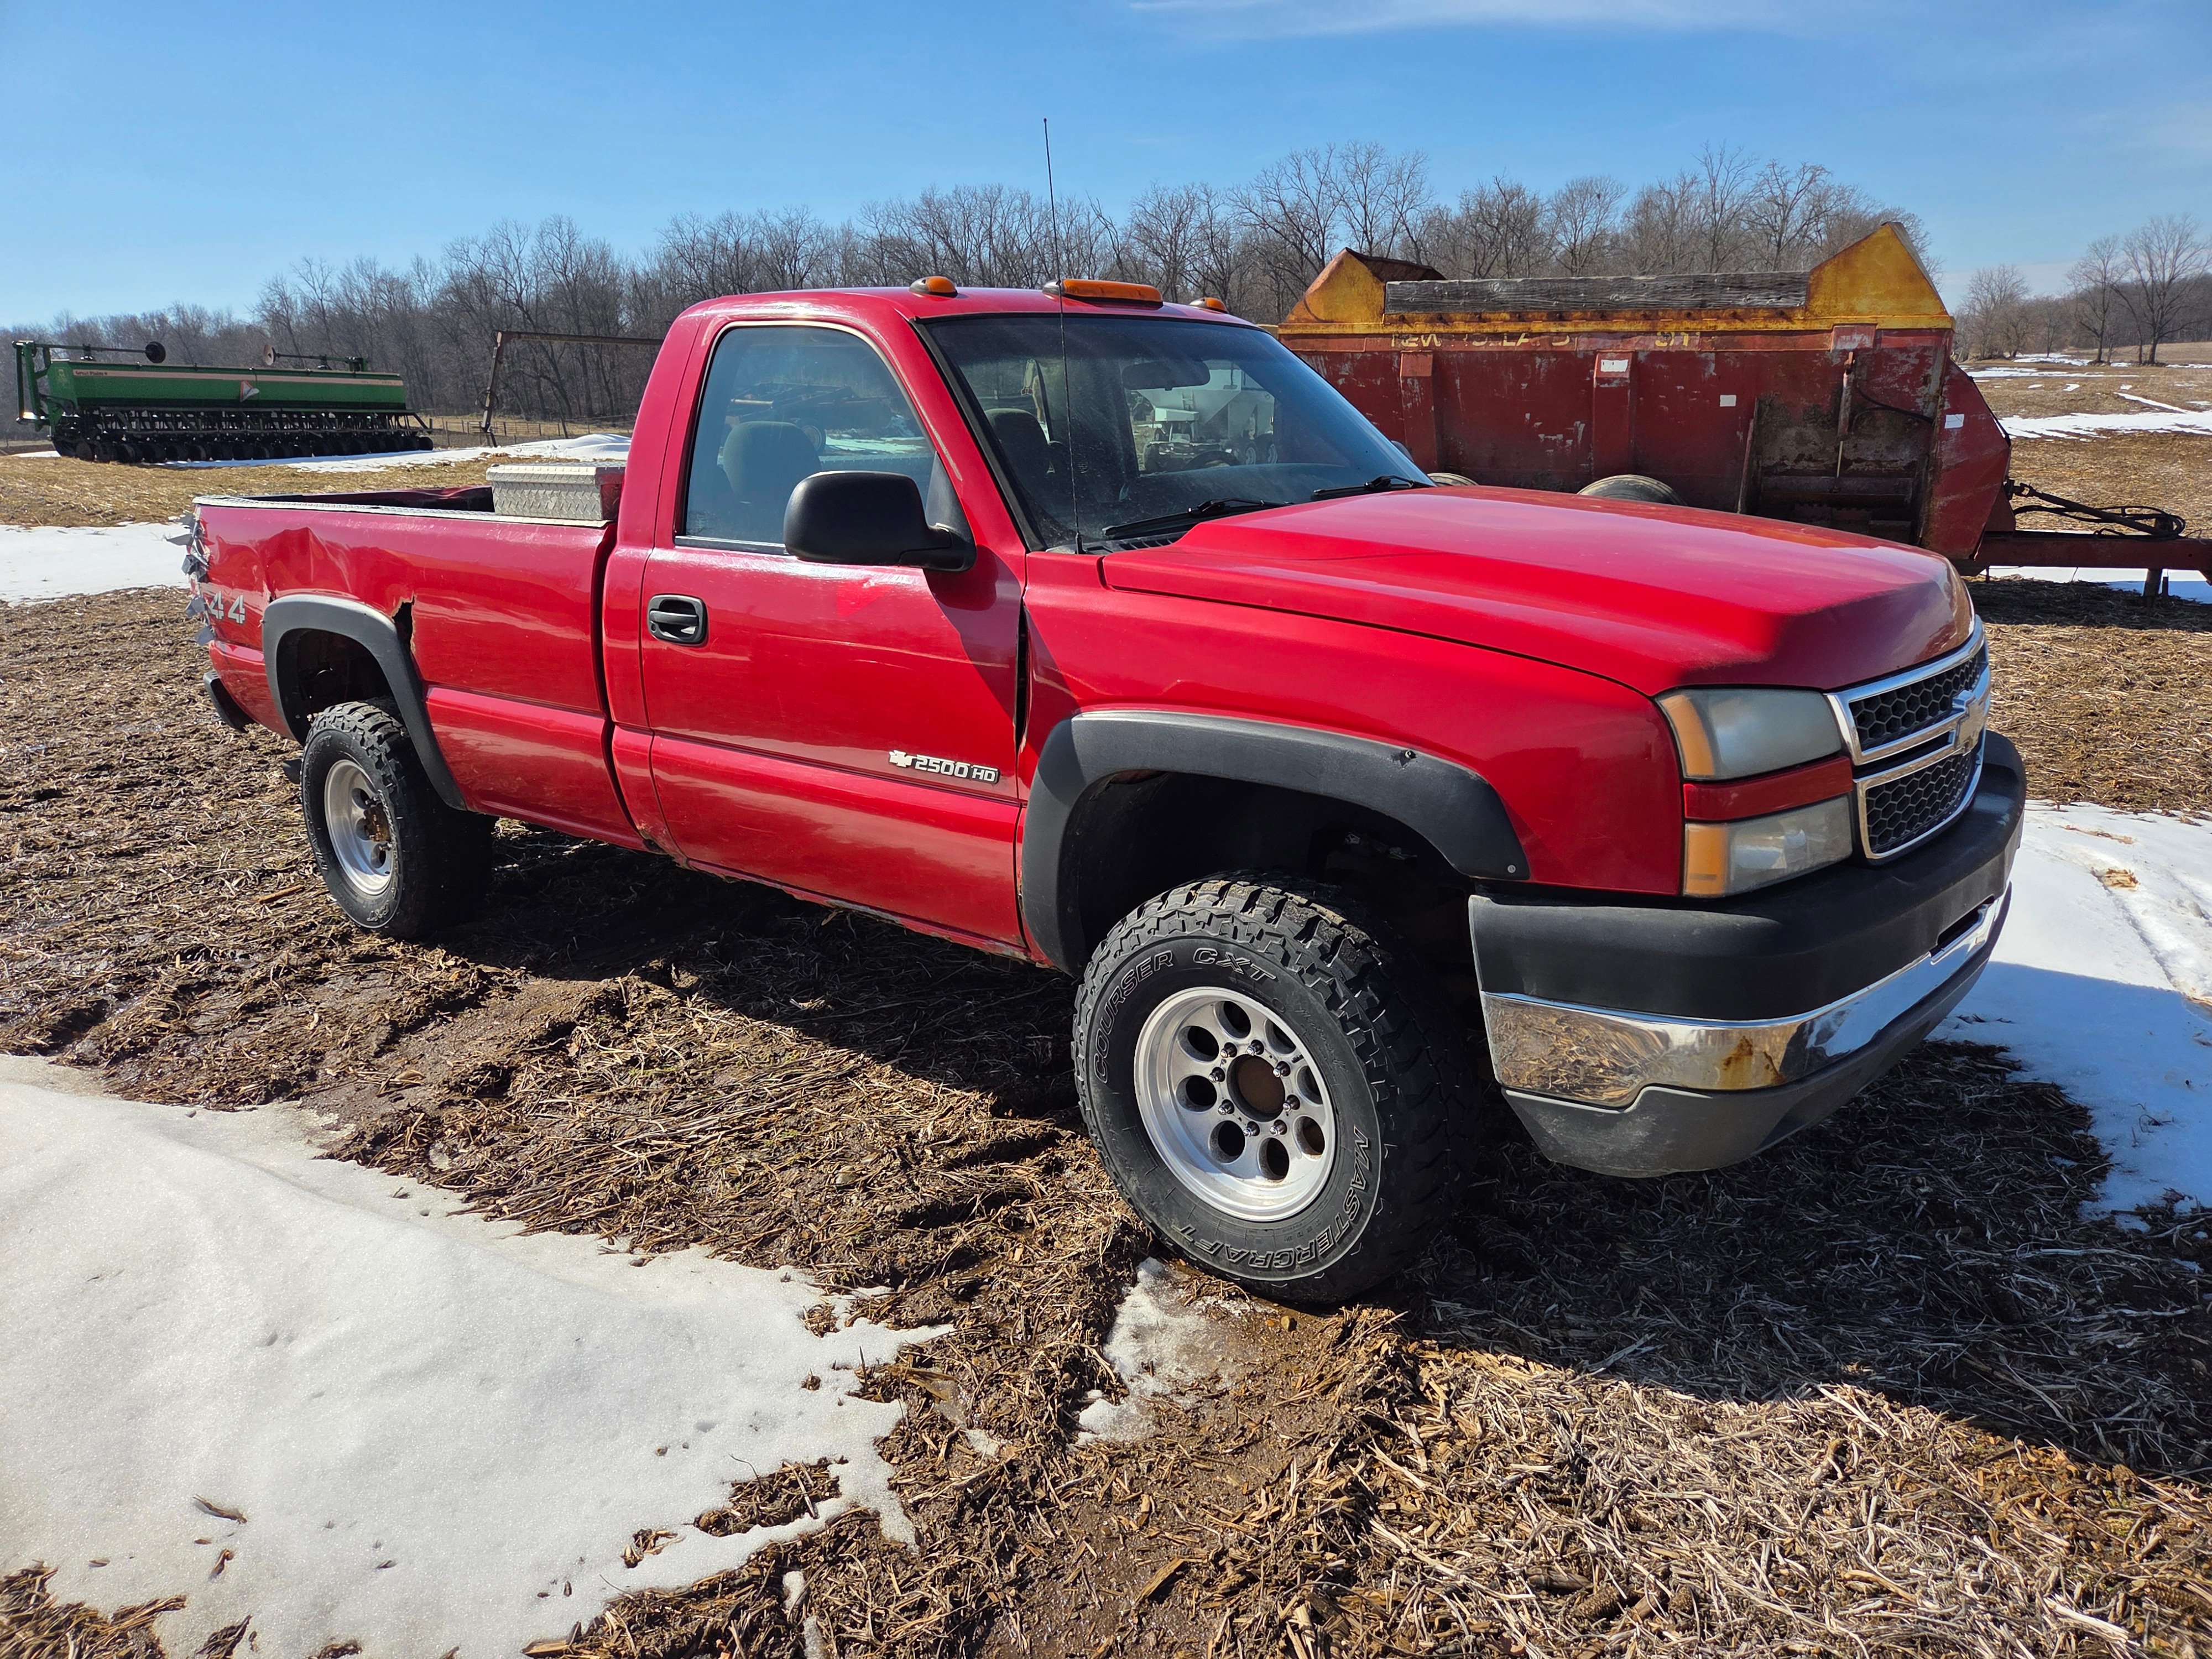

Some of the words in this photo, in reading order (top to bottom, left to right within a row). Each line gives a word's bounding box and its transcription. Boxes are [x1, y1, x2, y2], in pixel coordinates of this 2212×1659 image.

[915, 753, 969, 778] 2500
[972, 768, 997, 782] HD
[1093, 950, 1175, 1084] COURSER
[1192, 947, 1277, 982] CXT
[1171, 1124, 1371, 1270] MASTERCRAFT
